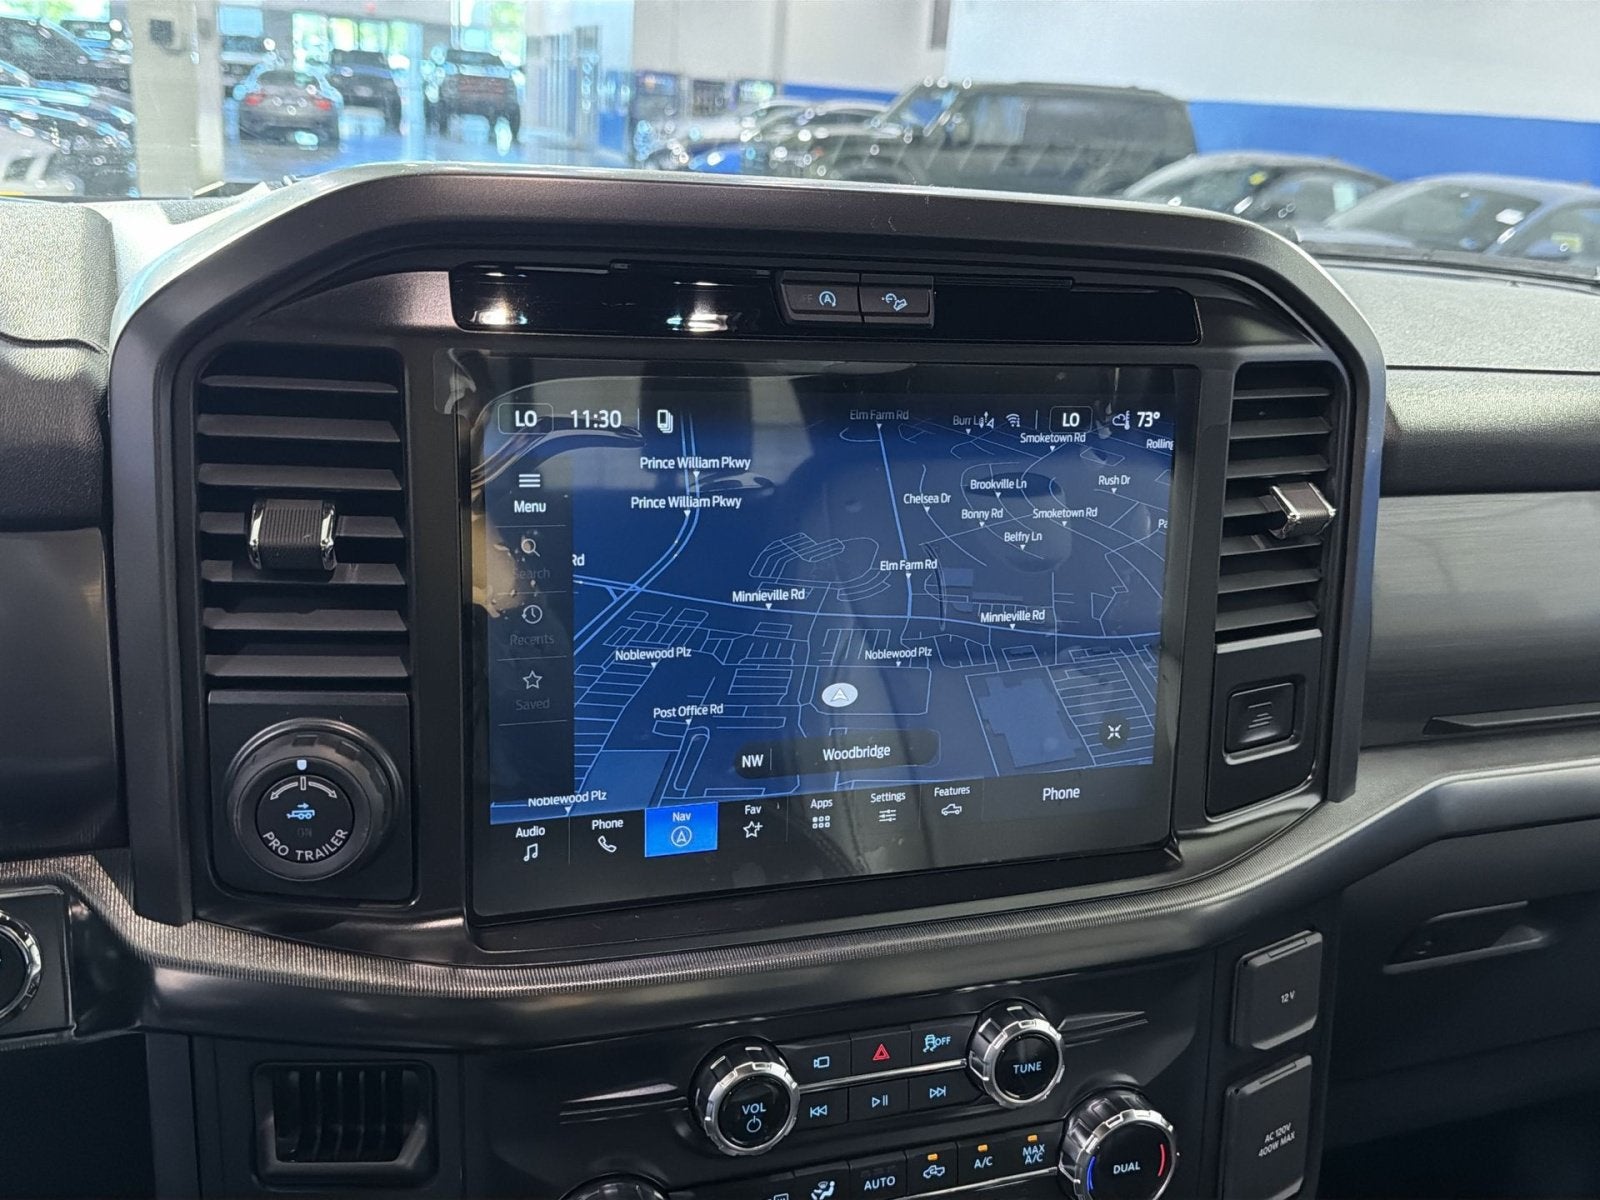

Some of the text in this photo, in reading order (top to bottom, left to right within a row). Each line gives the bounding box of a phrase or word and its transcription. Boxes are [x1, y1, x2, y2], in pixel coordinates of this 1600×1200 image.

[515, 409, 538, 428] LO
[570, 409, 622, 429] 11:30
[849, 409, 909, 421] Elm Farm Rd
[953, 415, 972, 426] Burr
[1062, 412, 1080, 427] LO
[1137, 411, 1161, 428] 73°
[1020, 431, 1087, 443] Smoketown Rd
[640, 455, 751, 471] Prince William Pkwy
[970, 479, 1027, 490] Brookville Ln
[1098, 474, 1131, 486] Rush Dr
[631, 495, 742, 511] Prince William Pkwy
[903, 493, 952, 505] Chelsea Dr
[513, 500, 547, 514] Menu
[1033, 507, 1098, 520] Smoketown Rd
[961, 507, 1003, 522] Bonny Rd
[1004, 531, 1042, 544] Belfry Ln
[880, 558, 938, 572] Elm Farm Rd
[732, 588, 805, 604] Minnieville Rd
[980, 610, 1045, 623] Minnieville Rd
[509, 633, 555, 646] Recents
[615, 646, 692, 661] Noblewood Plz
[864, 646, 932, 661] Noblewood Plz
[515, 698, 550, 710] Saved
[653, 703, 724, 719] Post Office Rd
[822, 744, 891, 762] Woodbridge
[741, 754, 764, 768] NW
[590, 790, 607, 802] Plz
[870, 790, 906, 805] Settings
[934, 785, 970, 797] Features
[1042, 785, 1080, 801] Phone
[744, 804, 762, 816] Fav
[810, 797, 833, 811] Apps
[672, 811, 691, 823] Nav
[592, 819, 624, 831] Phone
[515, 826, 546, 839] Audio
[262, 829, 348, 861] PRO TRAILER
[934, 1035, 952, 1047] OFF
[1013, 1060, 1042, 1074] TUNE
[742, 1102, 767, 1115] VOL
[1264, 1122, 1292, 1144] AC 120V
[1022, 1143, 1046, 1157] MAX
[1258, 1131, 1296, 1158] 400W MAX
[973, 1155, 993, 1170] A/C
[1023, 1152, 1044, 1167] A/C
[1112, 1160, 1141, 1175] DUAL
[863, 1175, 896, 1191] AUTO
